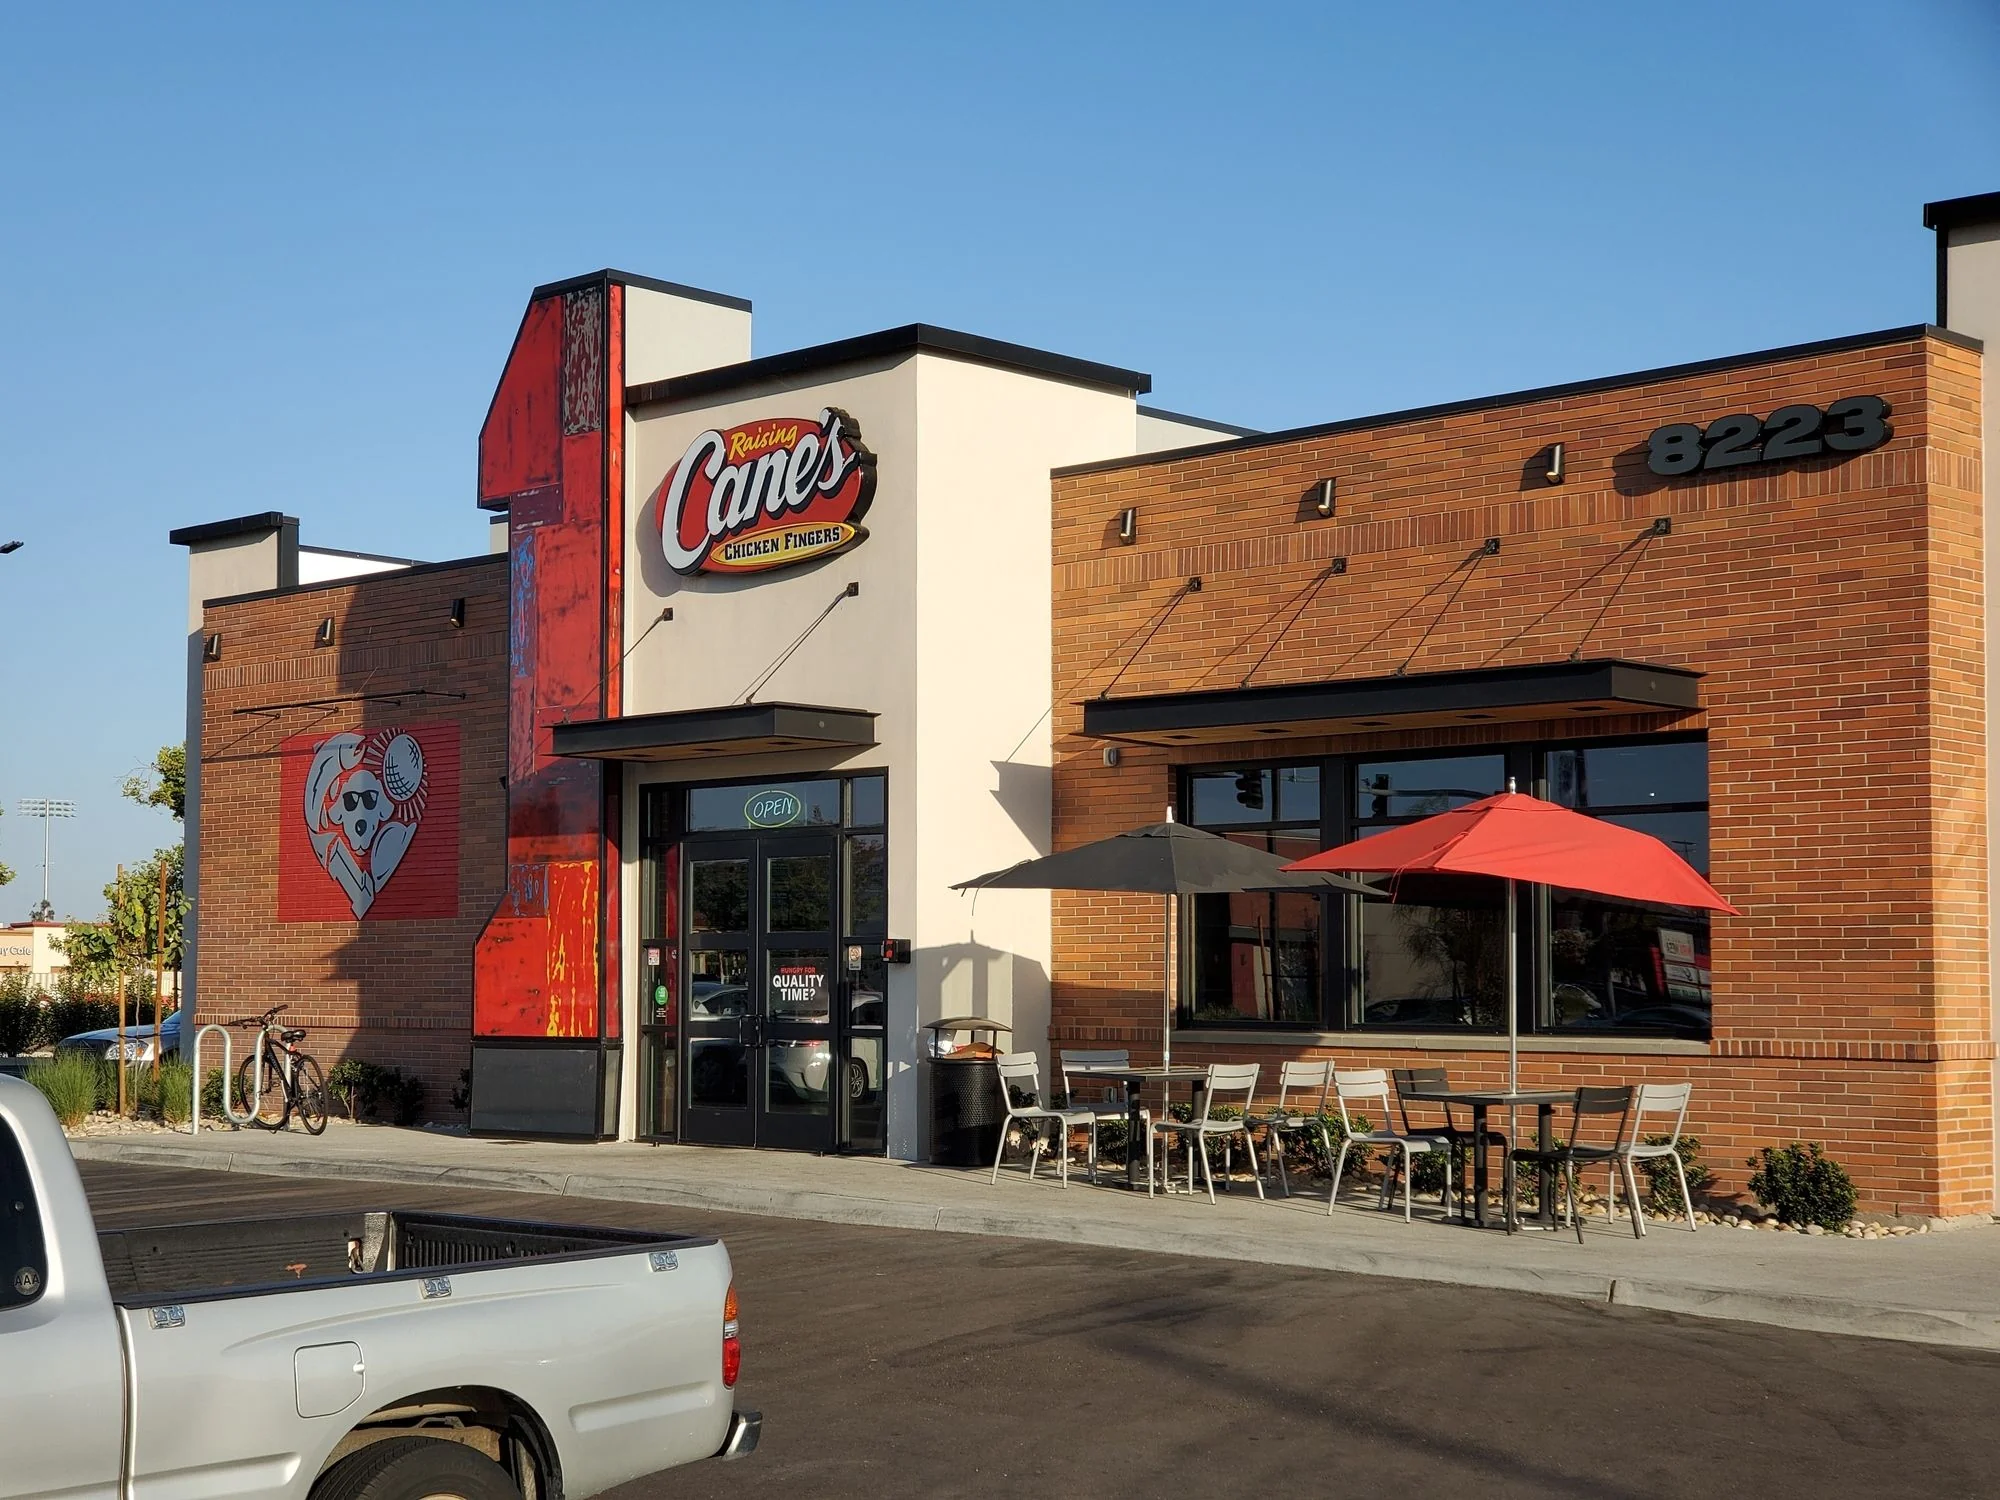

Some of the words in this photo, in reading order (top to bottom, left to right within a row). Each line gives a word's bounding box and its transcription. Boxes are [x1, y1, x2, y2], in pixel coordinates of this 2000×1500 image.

[729, 423, 798, 461] Raising
[1648, 395, 1891, 476] 8223
[661, 408, 857, 570] Cane's
[724, 537, 780, 561] CHICKEN
[784, 526, 841, 551] FINGERS
[753, 797, 793, 819] OPEN
[772, 974, 825, 988] QUALITY
[780, 988, 816, 1001] TIME?
[15, 1274, 40, 1286] AAA
